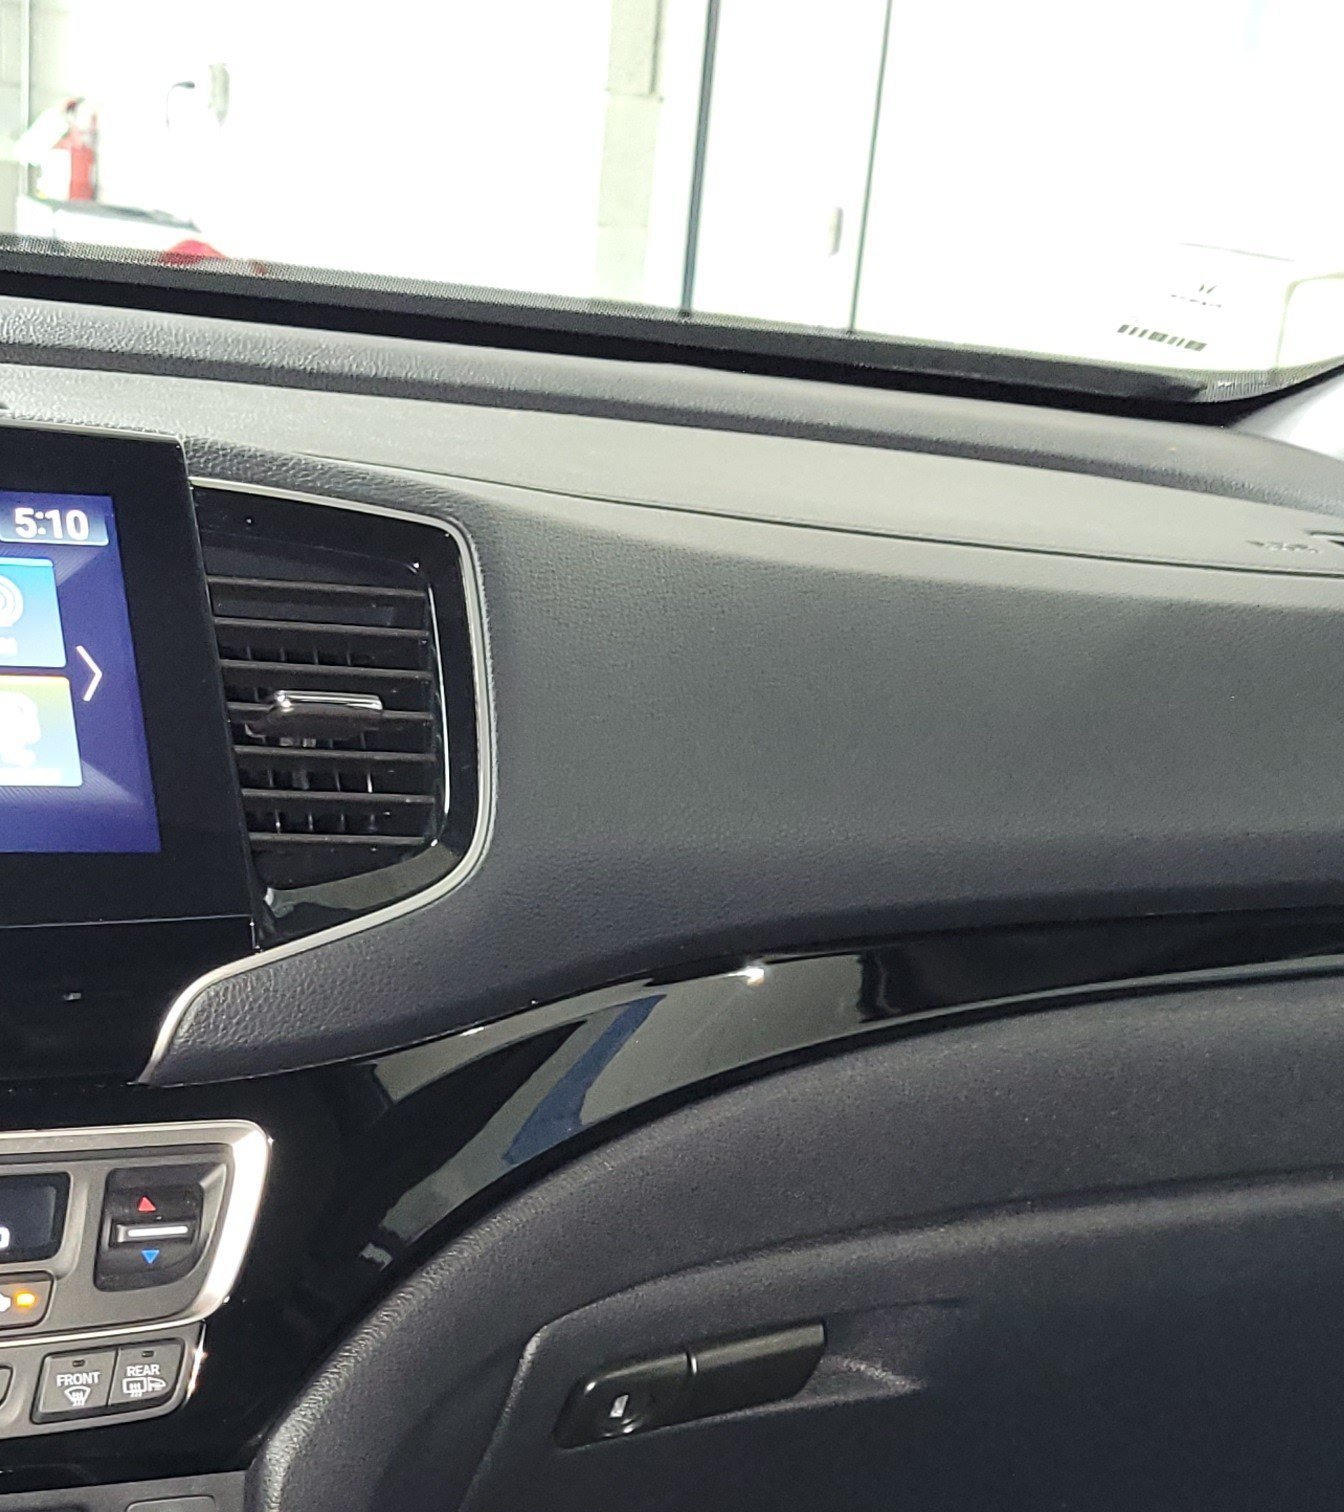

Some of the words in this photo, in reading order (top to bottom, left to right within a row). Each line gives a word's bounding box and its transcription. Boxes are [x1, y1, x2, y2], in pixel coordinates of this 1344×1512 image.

[14, 507, 89, 541] 5:10
[57, 1370, 100, 1387] FRONT
[126, 1363, 160, 1377] REAR
